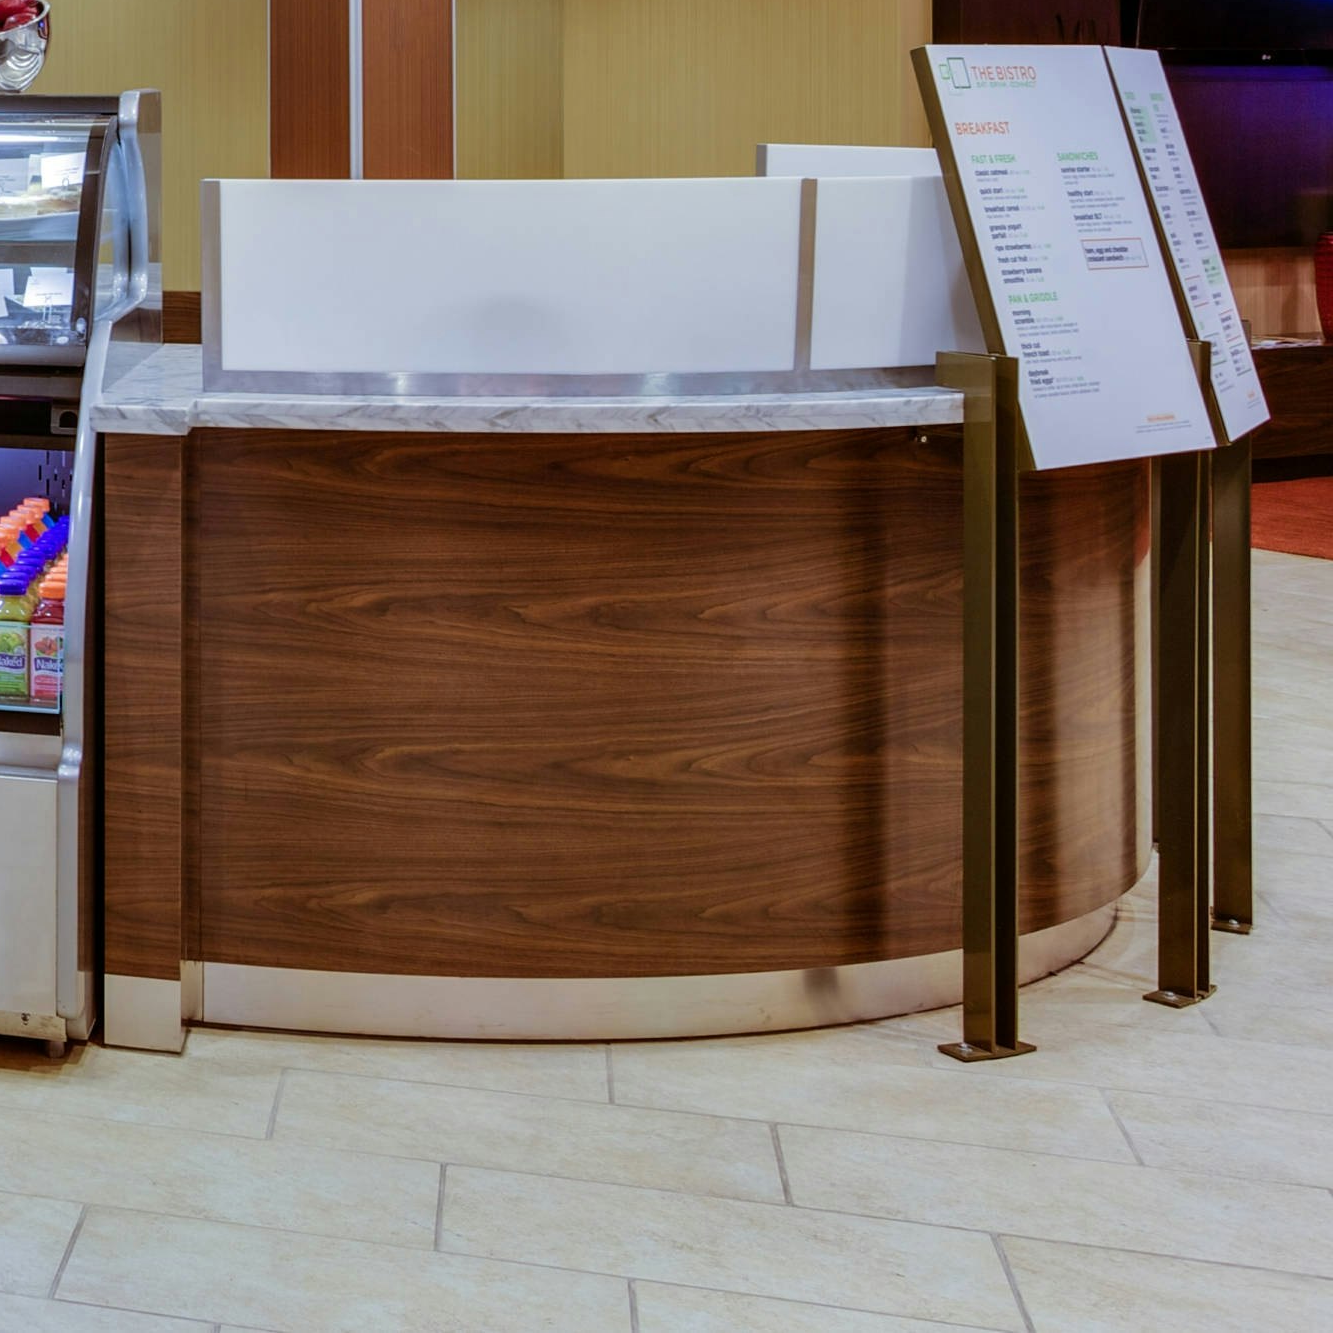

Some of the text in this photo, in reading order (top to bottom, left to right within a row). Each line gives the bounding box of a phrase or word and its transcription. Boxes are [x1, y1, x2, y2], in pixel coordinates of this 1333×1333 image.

[970, 66, 1037, 80] THE BISTRO
[954, 122, 1010, 135] BREAKFAST
